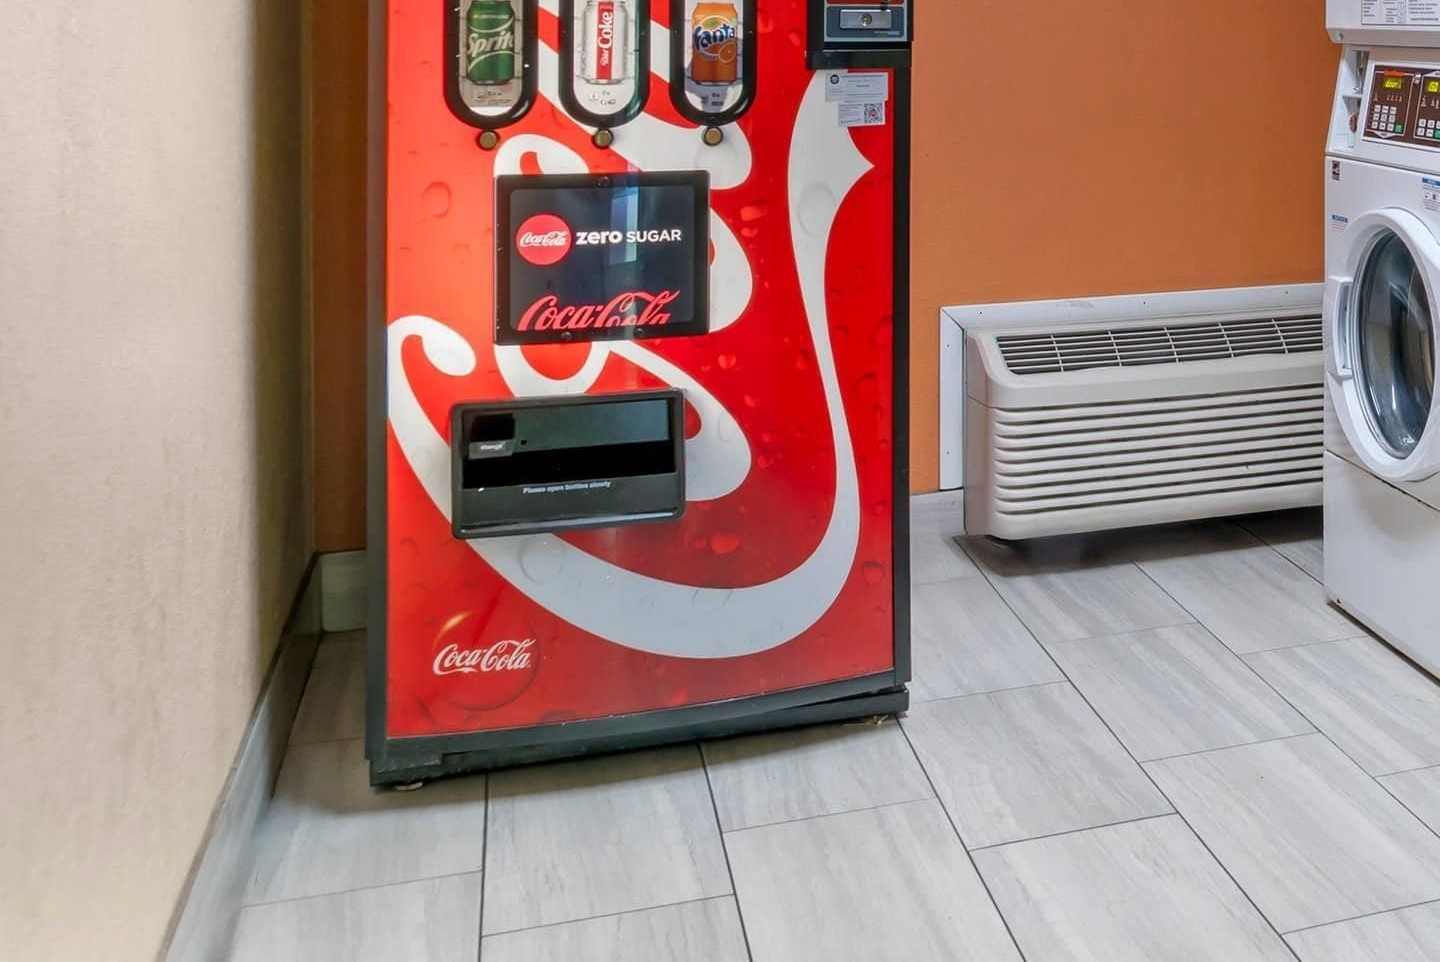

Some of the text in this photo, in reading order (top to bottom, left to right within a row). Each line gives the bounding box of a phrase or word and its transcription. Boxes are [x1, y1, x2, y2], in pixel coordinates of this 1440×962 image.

[597, 11, 614, 49] Coke
[519, 228, 682, 249] Coca-Cola zero SUGAR
[433, 638, 537, 676] Coca-Cola
